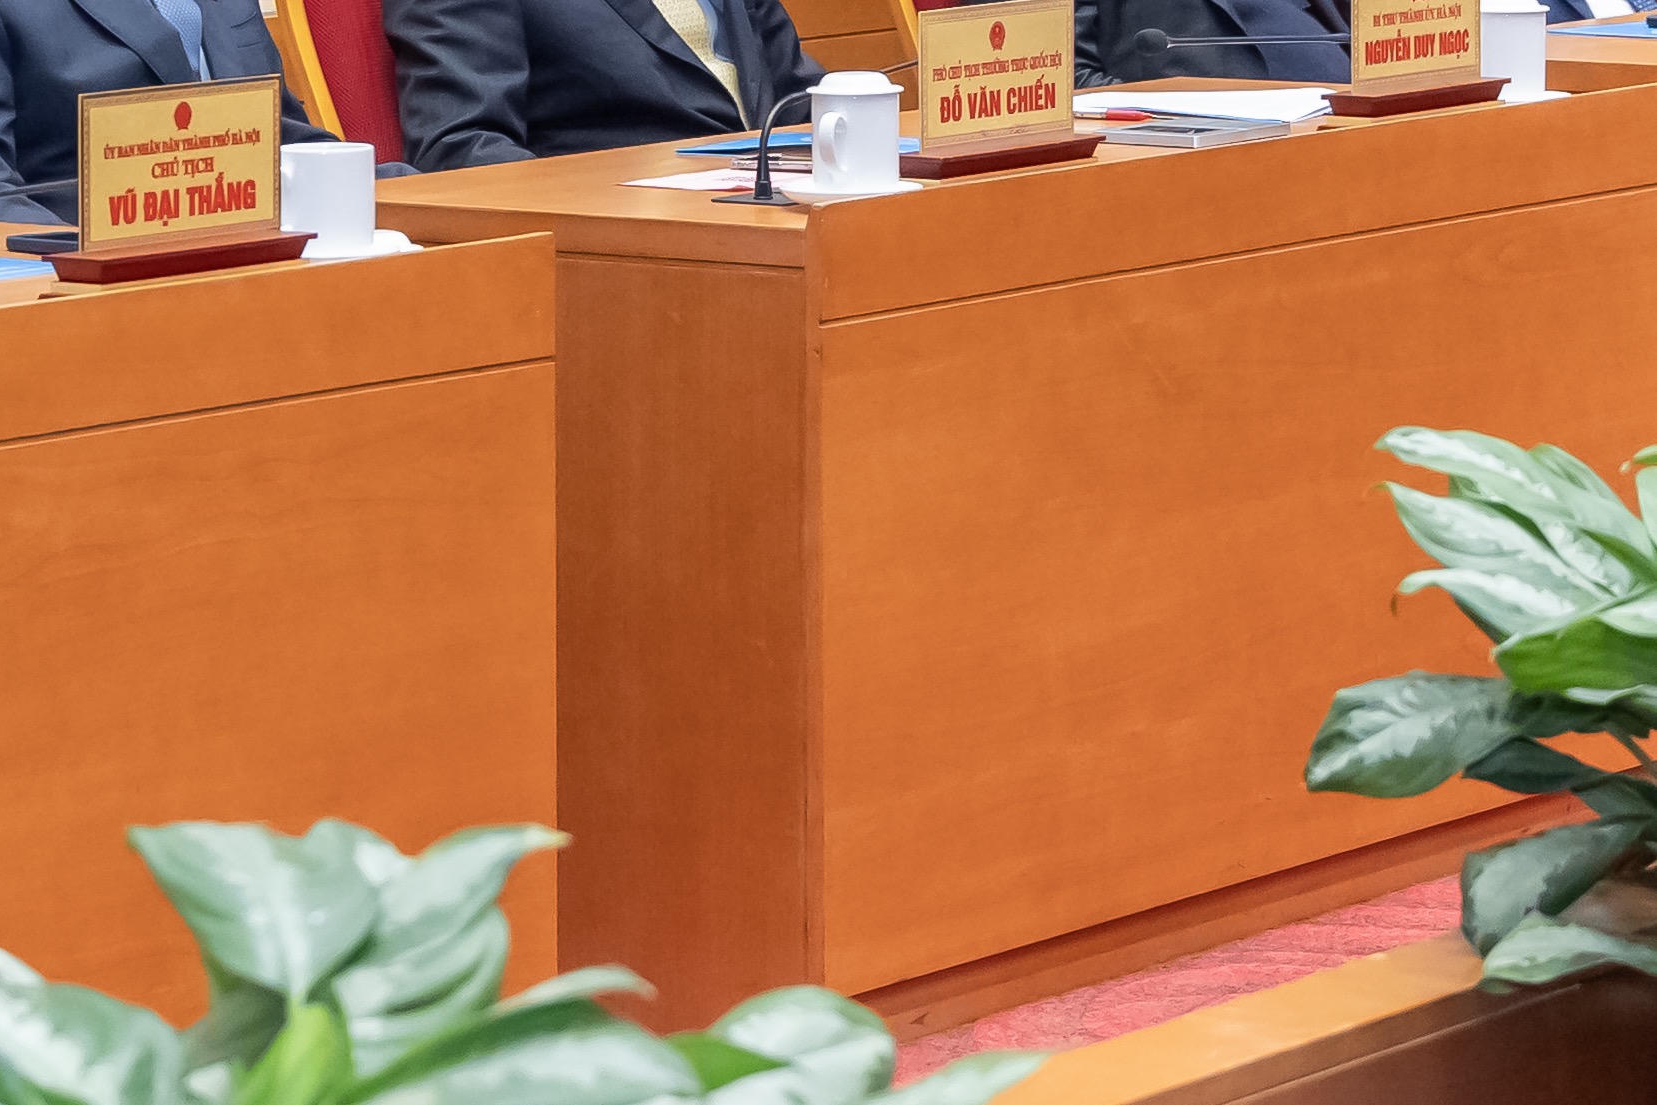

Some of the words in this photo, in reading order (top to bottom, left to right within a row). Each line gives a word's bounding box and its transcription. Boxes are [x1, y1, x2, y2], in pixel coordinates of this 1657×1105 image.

[1365, 29, 1410, 66] NGUYỄN
[1414, 33, 1435, 60] DUY
[1439, 29, 1469, 59] NGỌC
[939, 84, 962, 124] ĐỖ
[967, 86, 1001, 120] VĂN
[1006, 74, 1056, 115] CHIẾN
[232, 129, 243, 145] HÀ
[151, 156, 179, 179] CHỦ
[182, 156, 215, 178] TỊCH
[108, 187, 137, 226] VŨ
[143, 188, 180, 226] ĐẠI
[186, 172, 257, 217] THẮNG
